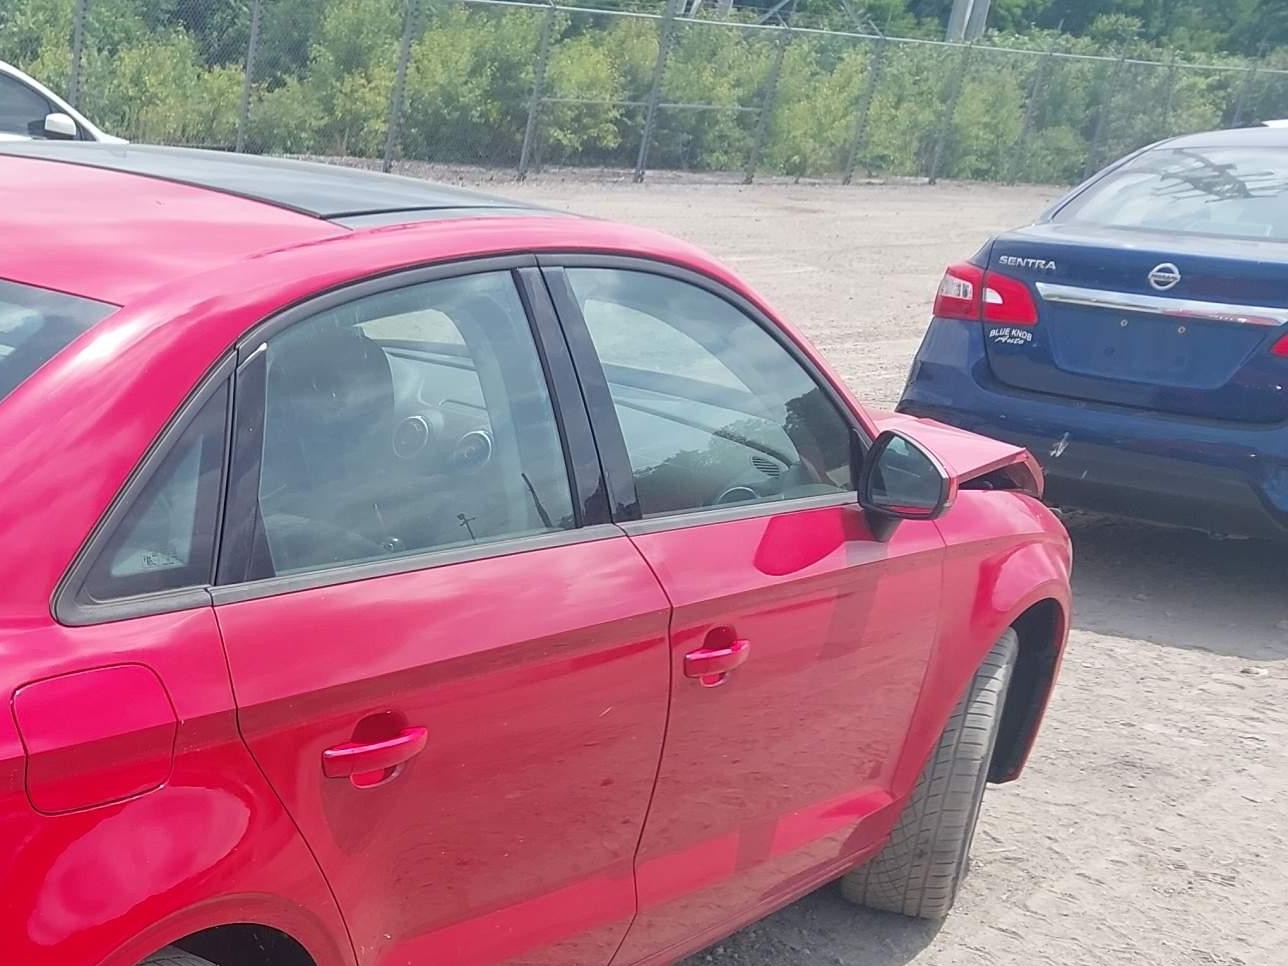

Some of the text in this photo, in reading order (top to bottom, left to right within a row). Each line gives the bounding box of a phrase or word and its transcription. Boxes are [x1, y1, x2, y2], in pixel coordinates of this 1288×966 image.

[999, 256, 1056, 270] SENTRA
[989, 328, 1032, 341] BLUE KNOB
